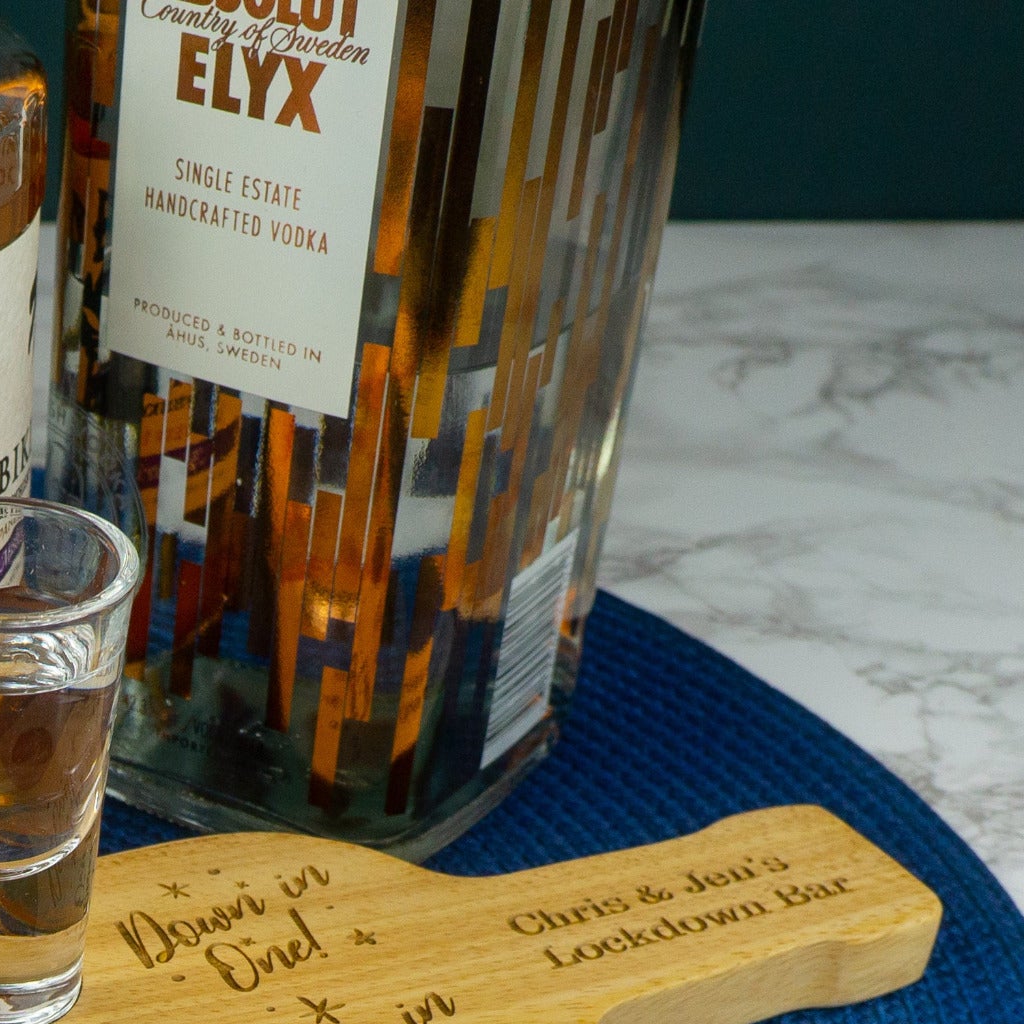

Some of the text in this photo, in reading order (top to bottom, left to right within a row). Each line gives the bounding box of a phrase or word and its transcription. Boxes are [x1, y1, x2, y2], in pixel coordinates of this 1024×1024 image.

[141, 0, 237, 51] Country
[238, 17, 275, 58] of
[270, 18, 371, 65] Sweden
[176, 32, 327, 134] ELYX
[144, 186, 328, 255] HANDCRAFTED VODKA
[174, 157, 302, 211] SINGLE ESTATE
[133, 297, 322, 364] PRODUCED & BOTTLED IN
[217, 341, 282, 371] SWEDEN
[115, 863, 330, 969] Down in
[507, 853, 790, 938] Chris & Jen's
[542, 874, 855, 970] Lockdown Bar
[204, 907, 329, 992] One!
